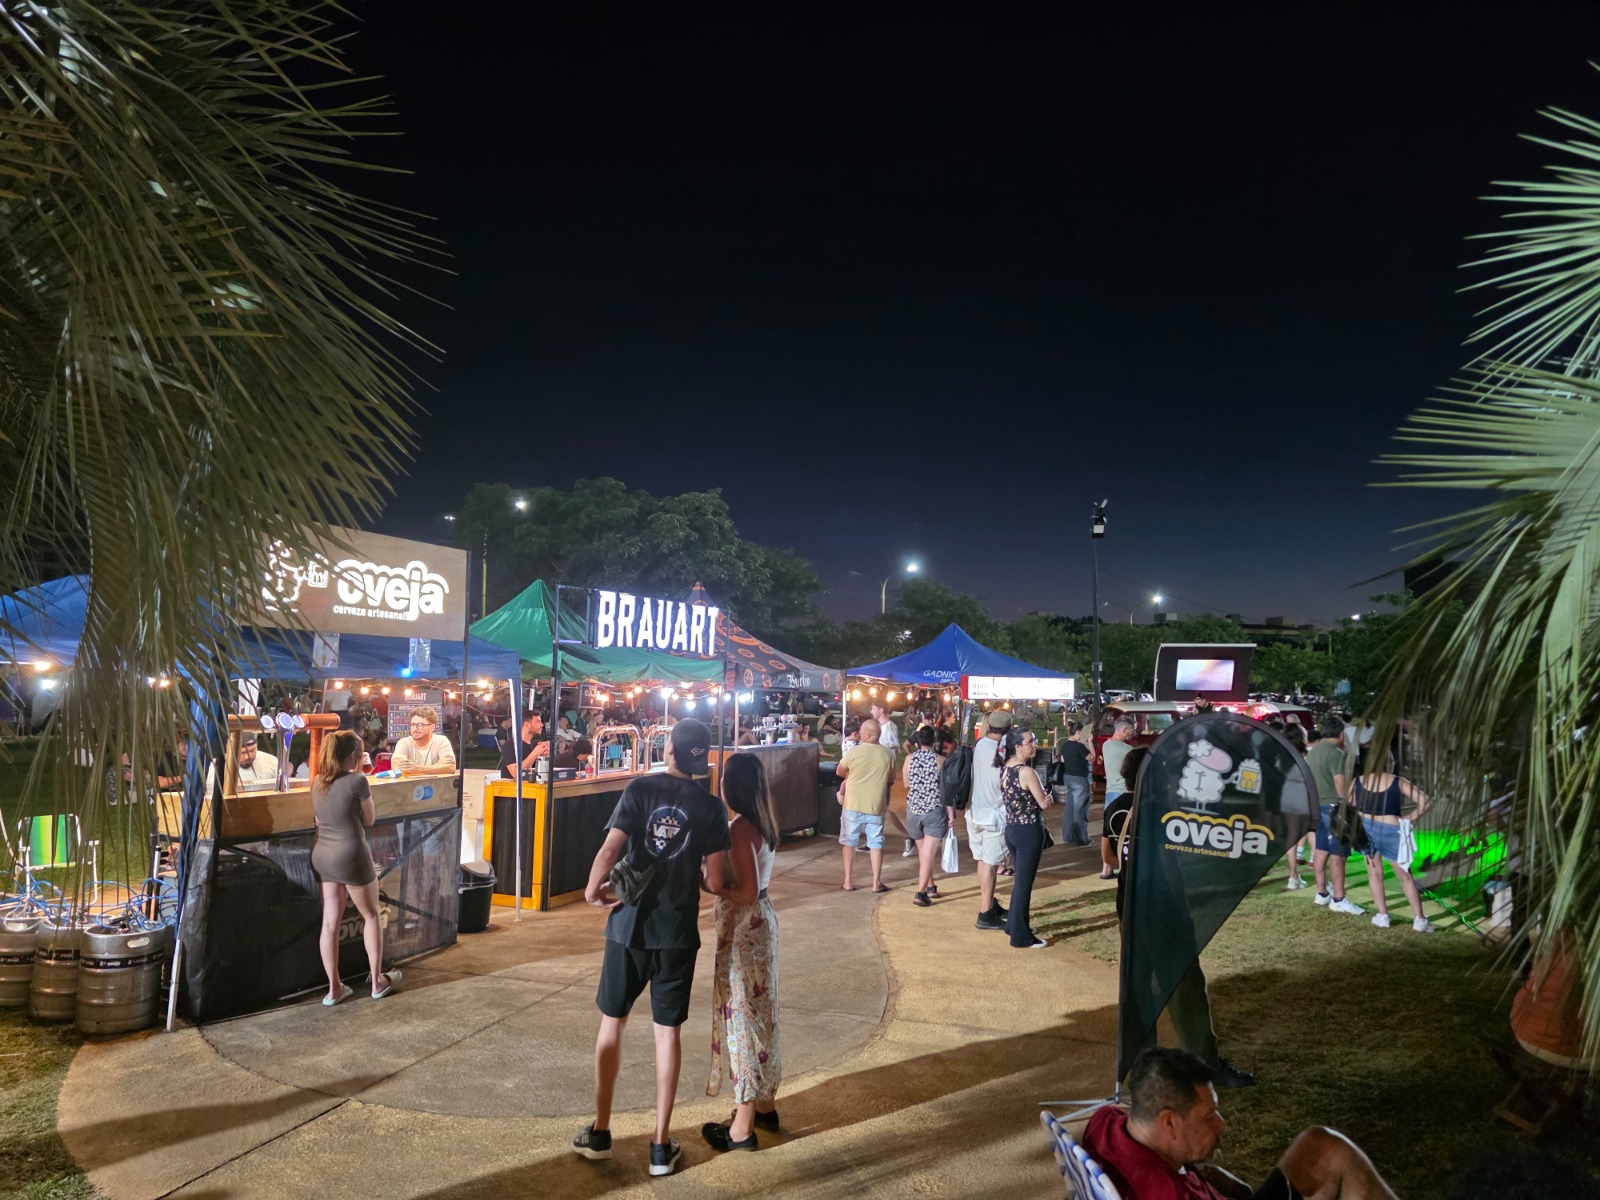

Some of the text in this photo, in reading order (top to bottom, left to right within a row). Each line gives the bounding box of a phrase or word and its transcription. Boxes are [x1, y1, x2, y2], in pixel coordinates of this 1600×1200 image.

[338, 569, 445, 621] oveja
[333, 605, 366, 616] cerveza
[598, 590, 719, 656] BRAUART
[923, 670, 957, 679] GADNIC
[1165, 819, 1268, 859] oveja
[1165, 843, 1229, 857] cerveza artesanal
